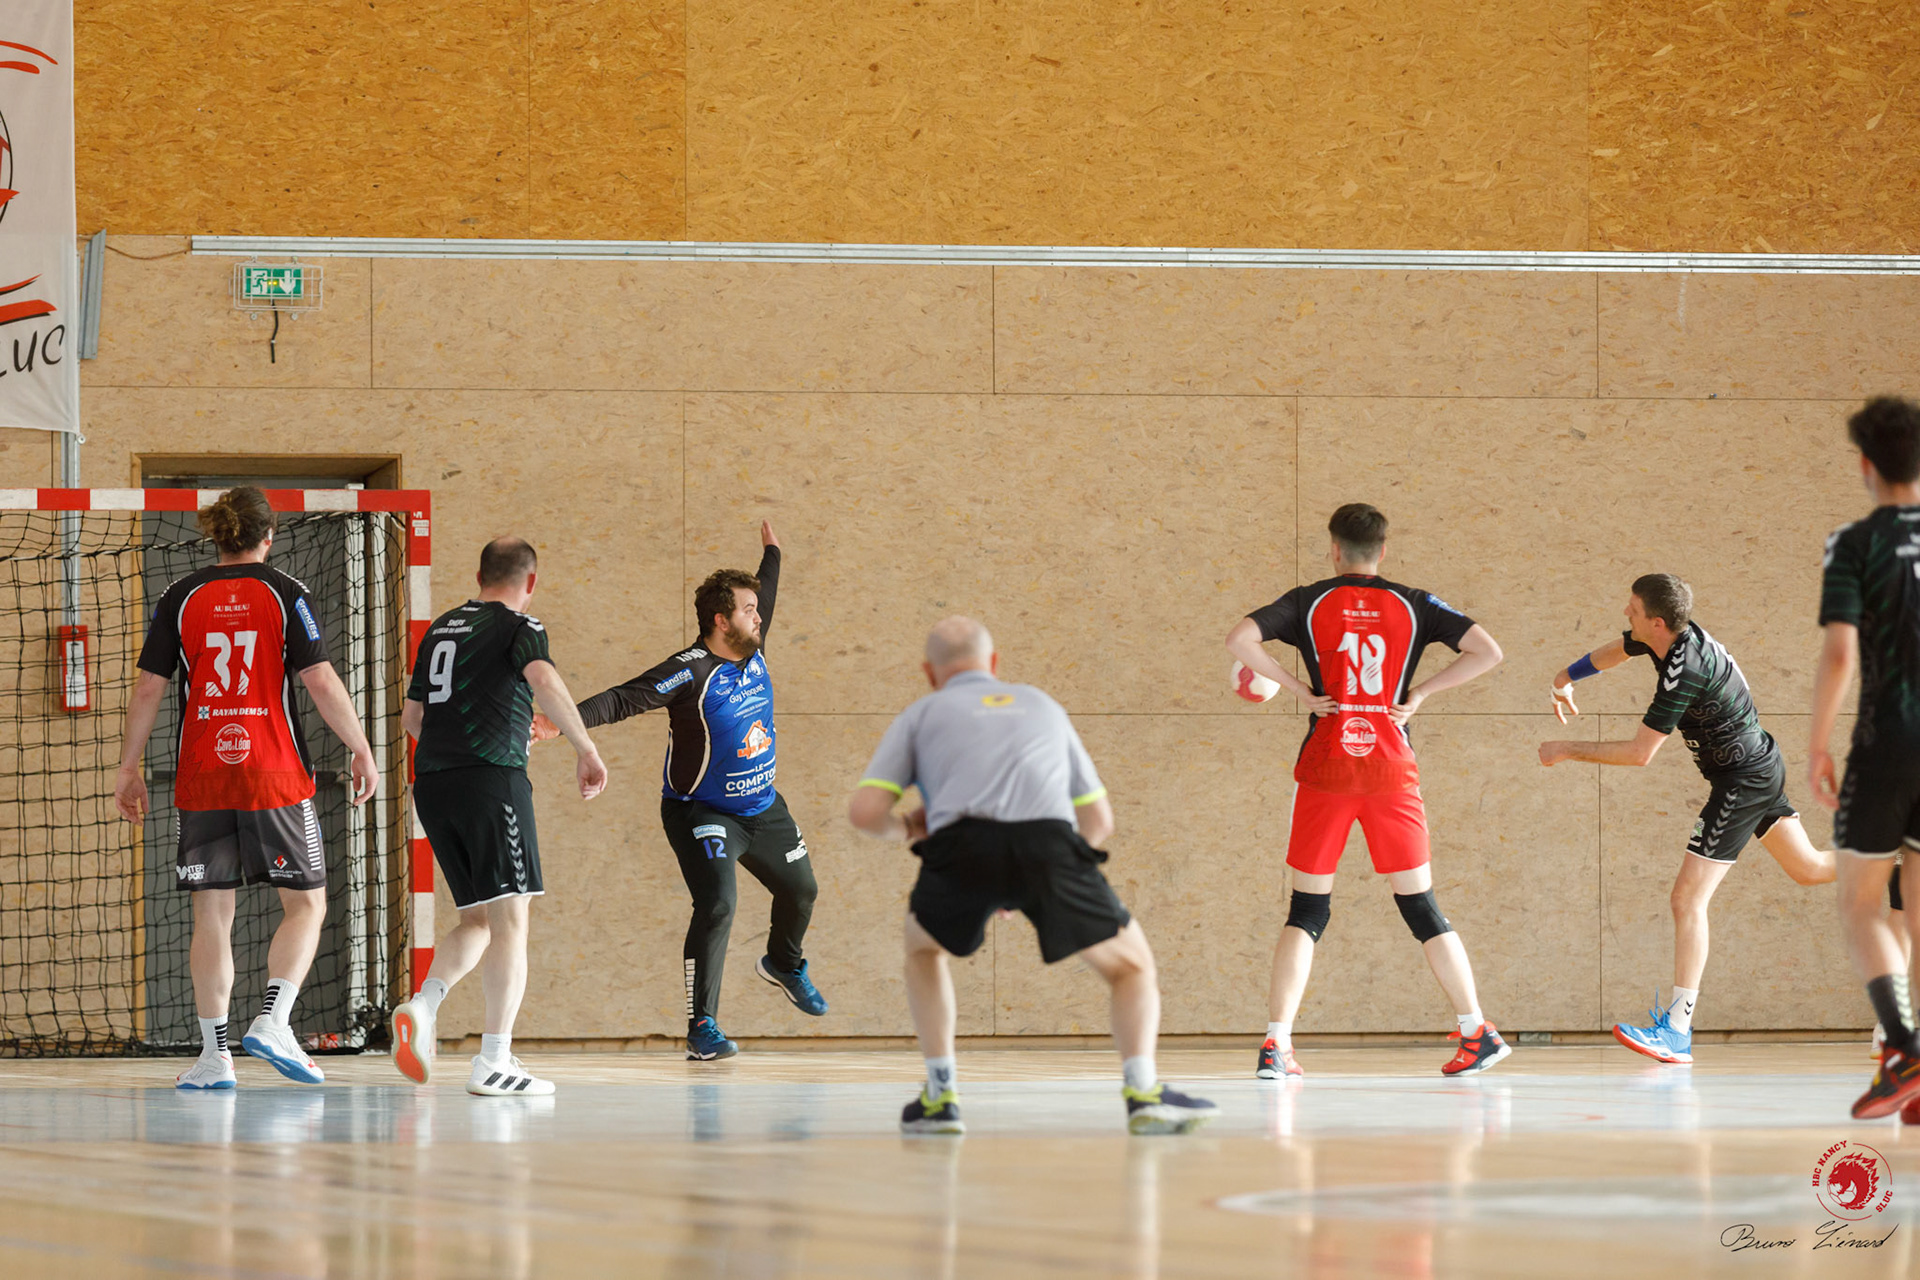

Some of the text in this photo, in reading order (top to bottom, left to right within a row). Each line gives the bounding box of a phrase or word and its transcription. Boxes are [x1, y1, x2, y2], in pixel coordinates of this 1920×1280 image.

[0, 324, 65, 377] UC
[298, 598, 320, 639] Grand Est
[205, 630, 258, 697] 37
[428, 639, 457, 705] 9
[1336, 631, 1387, 696] 18
[656, 669, 692, 692] Grand Est
[729, 694, 743, 704] Guy
[740, 683, 766, 699] Hoquet
[212, 707, 269, 717] RAYAN DEM 54
[726, 765, 777, 791] COMPTO
[755, 763, 765, 773] LE
[703, 838, 728, 860] 12
